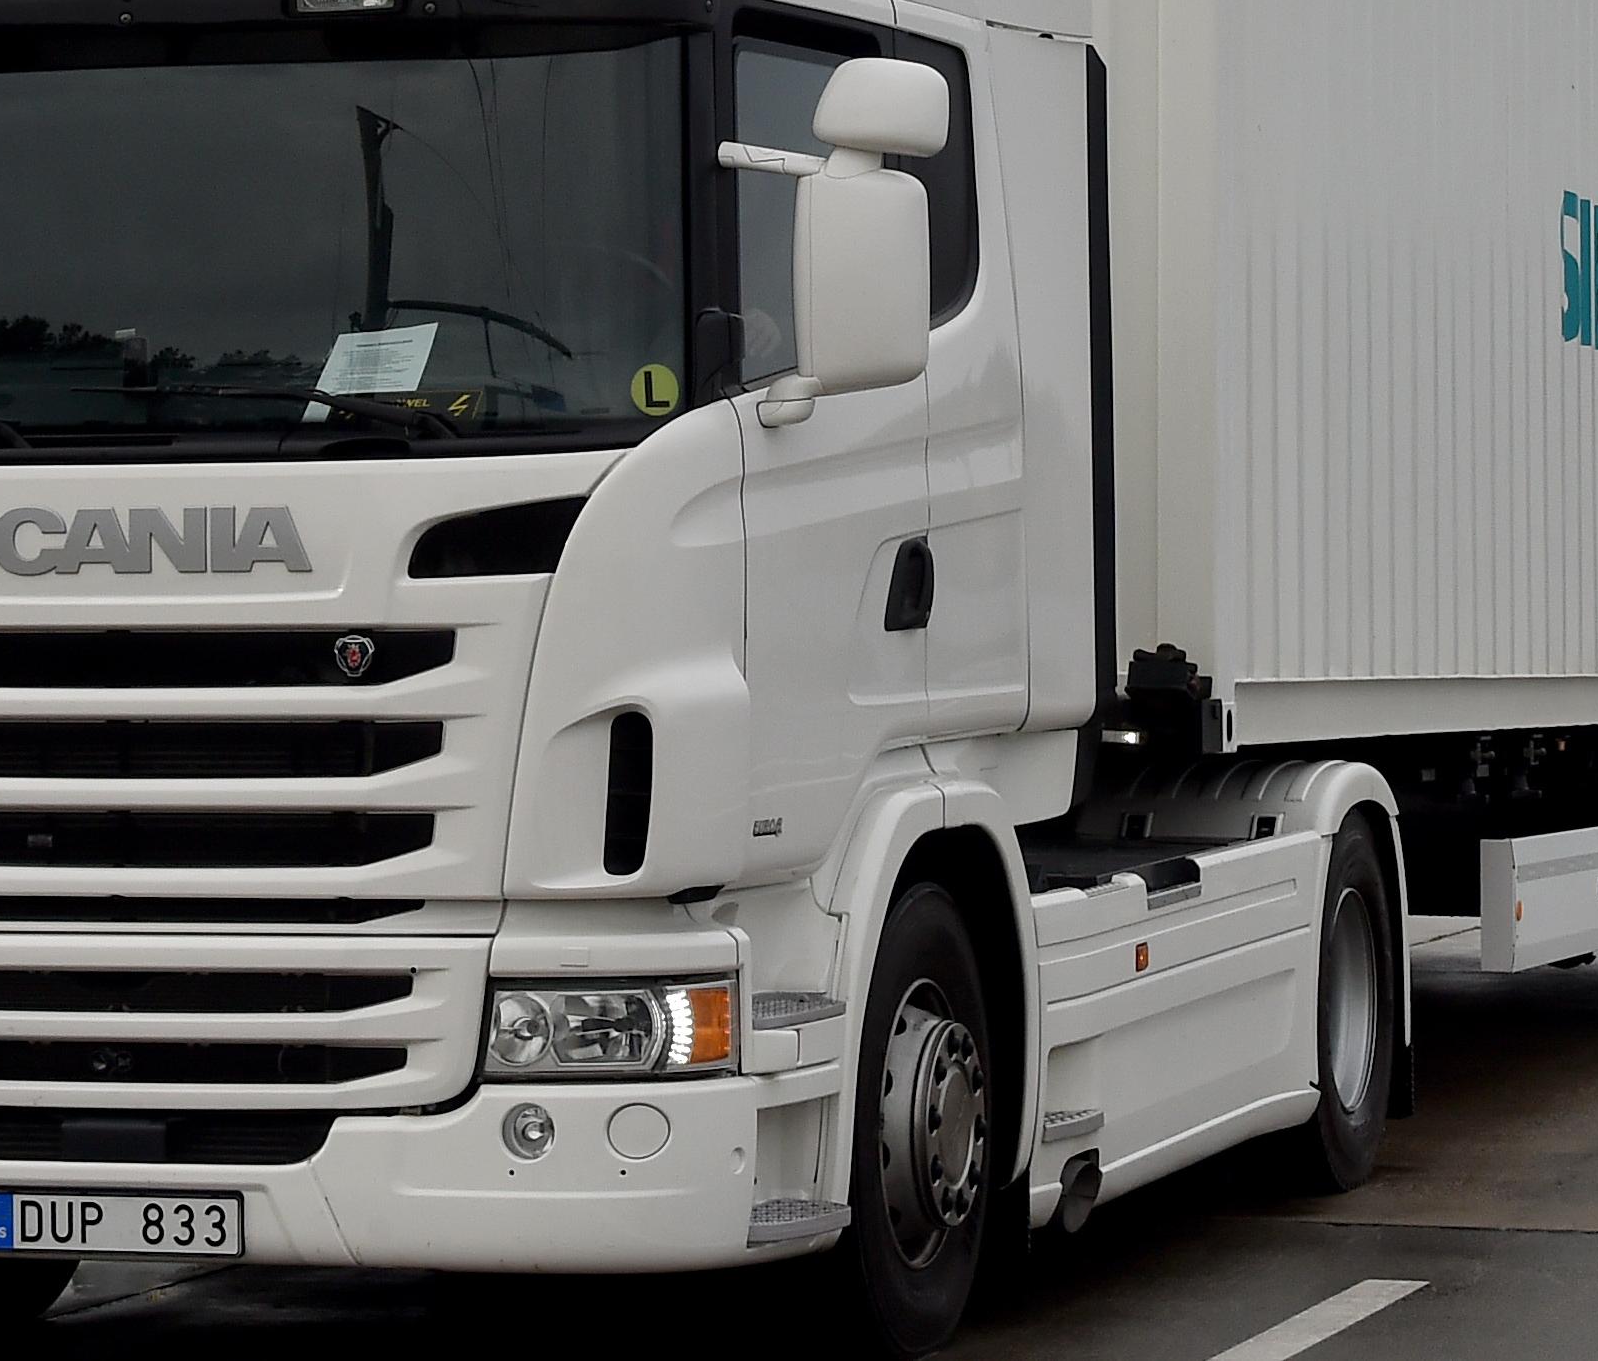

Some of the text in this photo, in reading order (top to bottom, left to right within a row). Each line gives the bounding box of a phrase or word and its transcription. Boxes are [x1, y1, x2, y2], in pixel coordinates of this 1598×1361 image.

[644, 370, 670, 408] L
[19, 1200, 104, 1244] DUP
[141, 1202, 227, 1247] 833
